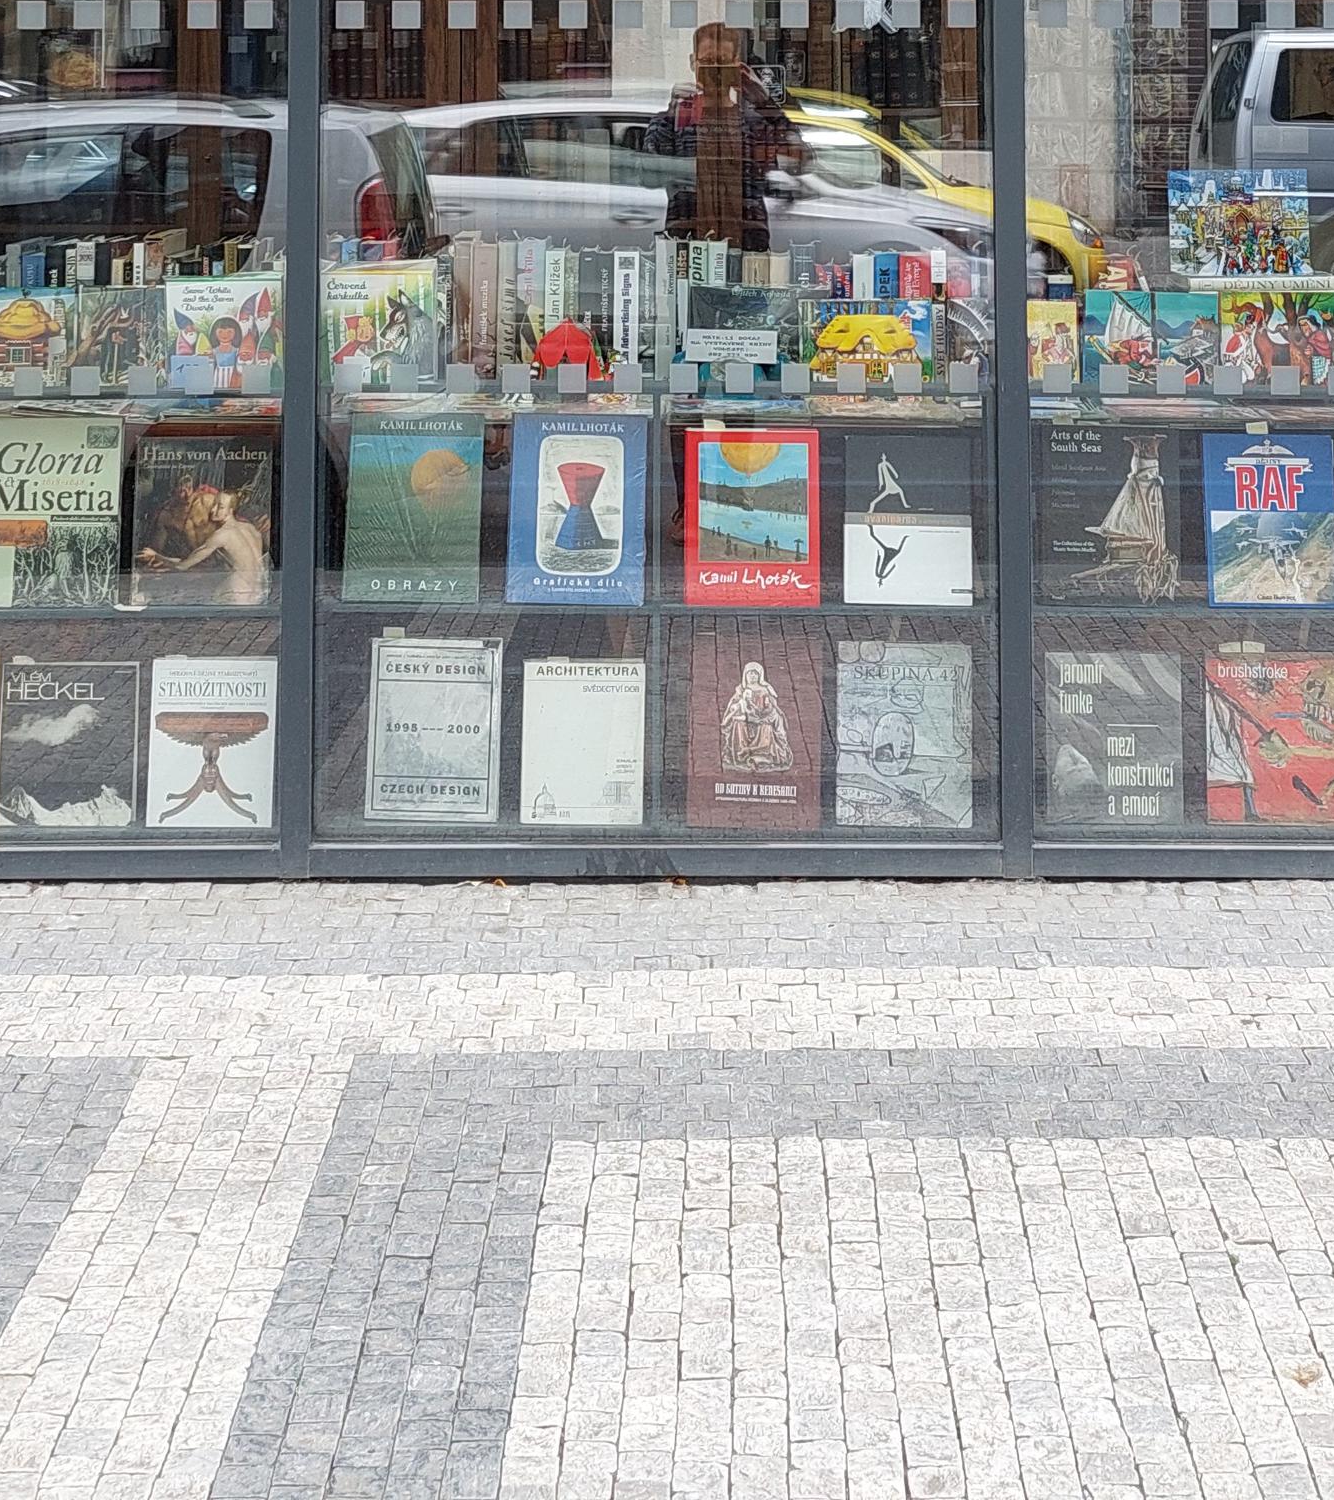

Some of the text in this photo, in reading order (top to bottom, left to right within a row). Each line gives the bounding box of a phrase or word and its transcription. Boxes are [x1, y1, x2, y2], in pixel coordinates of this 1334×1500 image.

[207, 286, 233, 294] White
[326, 278, 367, 291] Červená
[546, 258, 561, 320] Jan Křížek
[1222, 278, 1331, 290] DĚJINY UMĚNÍ
[326, 292, 370, 301] karkulka
[601, 292, 609, 332] FRANTIŠEK
[620, 273, 632, 349] Advertising Signs
[498, 277, 515, 361] josef šíma
[934, 306, 944, 345] HUDBY
[380, 420, 464, 431] KAMIL LHOTÁK
[542, 421, 625, 433] KAMIL LHOTÁK
[1050, 430, 1101, 441] Arts of the
[143, 446, 268, 461] Hans von Aachen
[1050, 442, 1102, 453] South Seas
[1234, 464, 1304, 511] RAF
[371, 579, 459, 591] OBRAZY
[533, 577, 590, 587] Grafické
[698, 568, 813, 589] Kamil Lhoták
[385, 661, 485, 675] ČESKÝ DESIGN
[536, 665, 639, 677] ARCHITEKTURA
[853, 665, 958, 681] SKUPINA 42
[1059, 660, 1104, 686] jaromír
[1217, 664, 1288, 679] brushstroke
[10, 671, 52, 683] VILÉM
[6, 682, 105, 701] HECKEL
[158, 679, 266, 698] STAROŽITNOSTI
[582, 683, 622, 693] SVĚDECTVÍ
[1059, 690, 1093, 714] funke
[385, 723, 481, 734] 1995 2000
[1107, 732, 1135, 758] mezi
[1107, 761, 1174, 788] konstrukcí
[380, 784, 481, 796] CZECH DESIGN
[715, 783, 797, 796] OD GOTIKY K RENESANCI
[1108, 792, 1161, 817] a emocí
